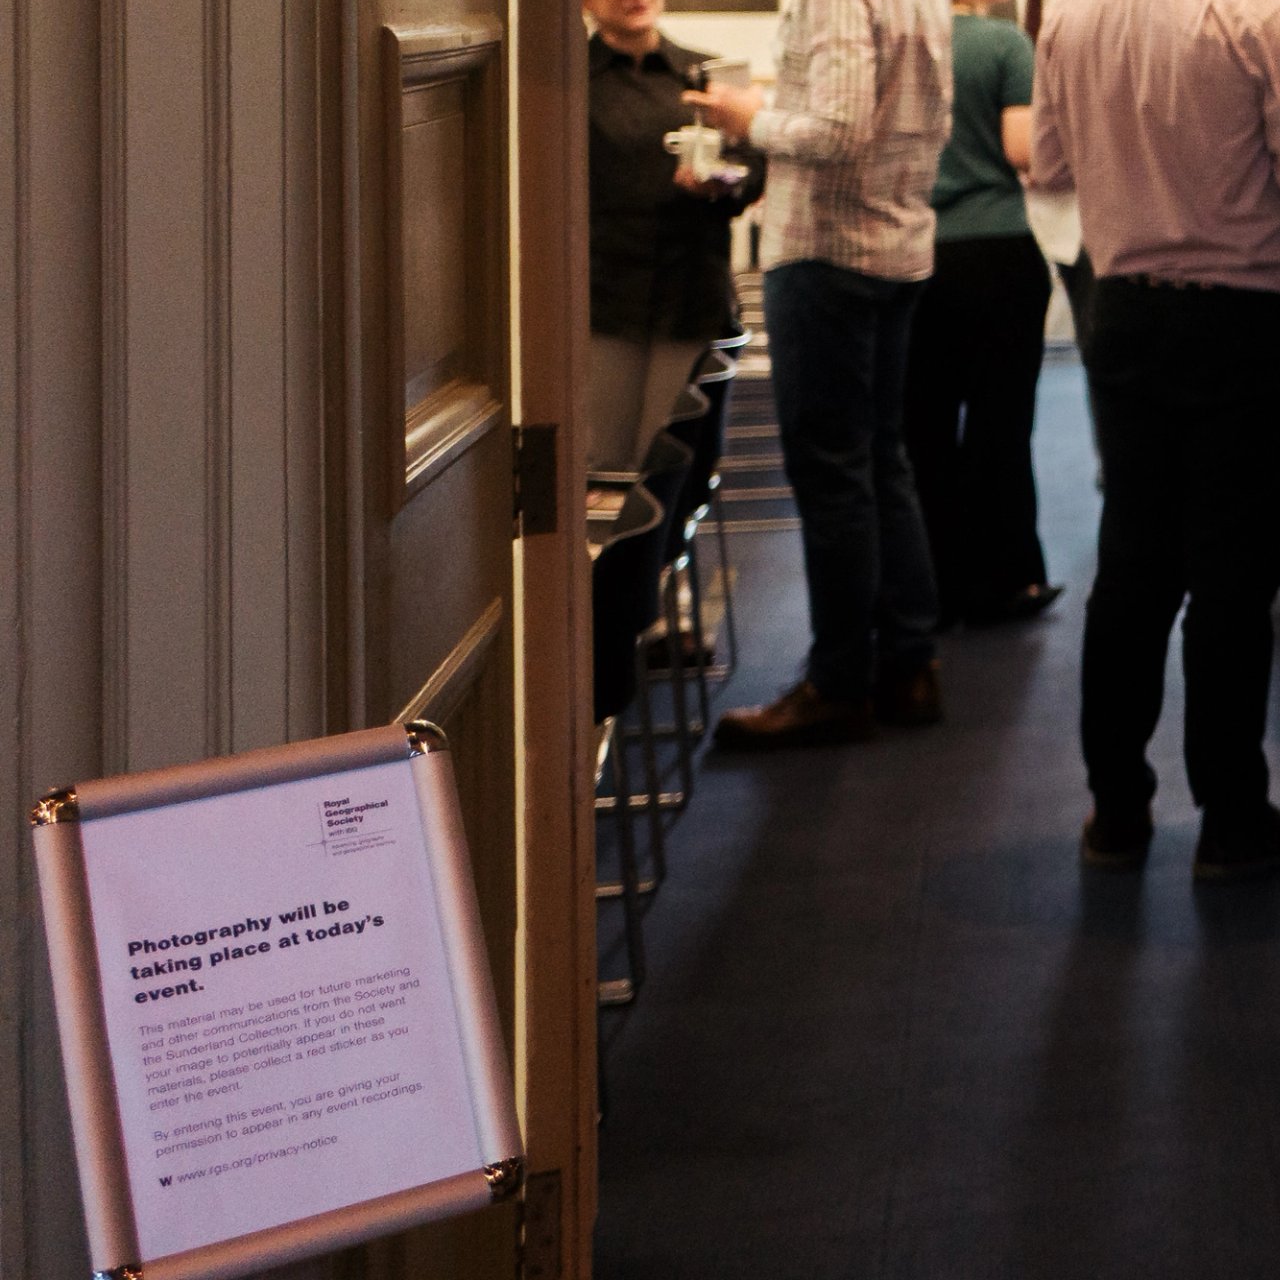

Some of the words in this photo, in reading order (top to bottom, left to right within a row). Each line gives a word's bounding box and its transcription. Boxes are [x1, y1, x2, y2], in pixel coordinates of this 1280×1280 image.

[323, 798, 350, 809] Royal
[325, 800, 388, 817] Geographical
[327, 816, 363, 827] Society
[127, 917, 272, 957] Photography
[278, 904, 316, 924] will
[323, 900, 350, 915] be
[130, 956, 202, 980] taking
[210, 942, 271, 967] place
[278, 933, 300, 949] at
[134, 979, 204, 1004] event.
[138, 1024, 164, 1036] This
[168, 1011, 215, 1030] material
[219, 1007, 244, 1018] may
[248, 1002, 263, 1012] be
[267, 993, 296, 1007] used
[299, 989, 315, 999] for
[318, 981, 351, 994] future
[355, 967, 410, 986] marketing
[141, 1038, 164, 1052] and
[168, 1032, 198, 1045] other
[203, 1008, 300, 1036] communications
[303, 1001, 329, 1013] from
[333, 996, 351, 1006] the
[354, 986, 395, 1001] Society
[399, 978, 420, 991] and
[142, 1056, 162, 1066] the
[166, 1037, 234, 1060] Sunderland
[314, 1014, 335, 1027] you
[339, 1010, 354, 1019] do
[358, 1003, 376, 1014] not
[379, 996, 406, 1010] want
[145, 1068, 170, 1083] your
[176, 1059, 212, 1073] image
[217, 1055, 228, 1063] to
[232, 1039, 291, 1062] potentially
[296, 1029, 335, 1045] appear
[340, 1026, 350, 1034] in
[354, 1017, 385, 1030] these
[210, 1065, 249, 1082] please
[253, 1054, 292, 1071] collect
[296, 1052, 303, 1060] a
[307, 1045, 326, 1057] red
[329, 1036, 366, 1052] sticker
[371, 1032, 385, 1042] as
[387, 1026, 409, 1039] you
[149, 1097, 179, 1111] enter
[184, 1091, 203, 1103] the
[153, 1130, 169, 1142] By
[173, 1118, 223, 1137] entering
[226, 1111, 248, 1124] this
[290, 1096, 312, 1109] you
[315, 1090, 334, 1101] are
[338, 1080, 372, 1098] giving
[375, 1073, 400, 1087] your
[155, 1133, 222, 1159] permission
[226, 1130, 238, 1140] to
[242, 1118, 283, 1135] appear
[287, 1115, 298, 1124] in
[302, 1109, 322, 1120] any
[326, 1098, 358, 1114] event
[158, 1175, 173, 1189] W
